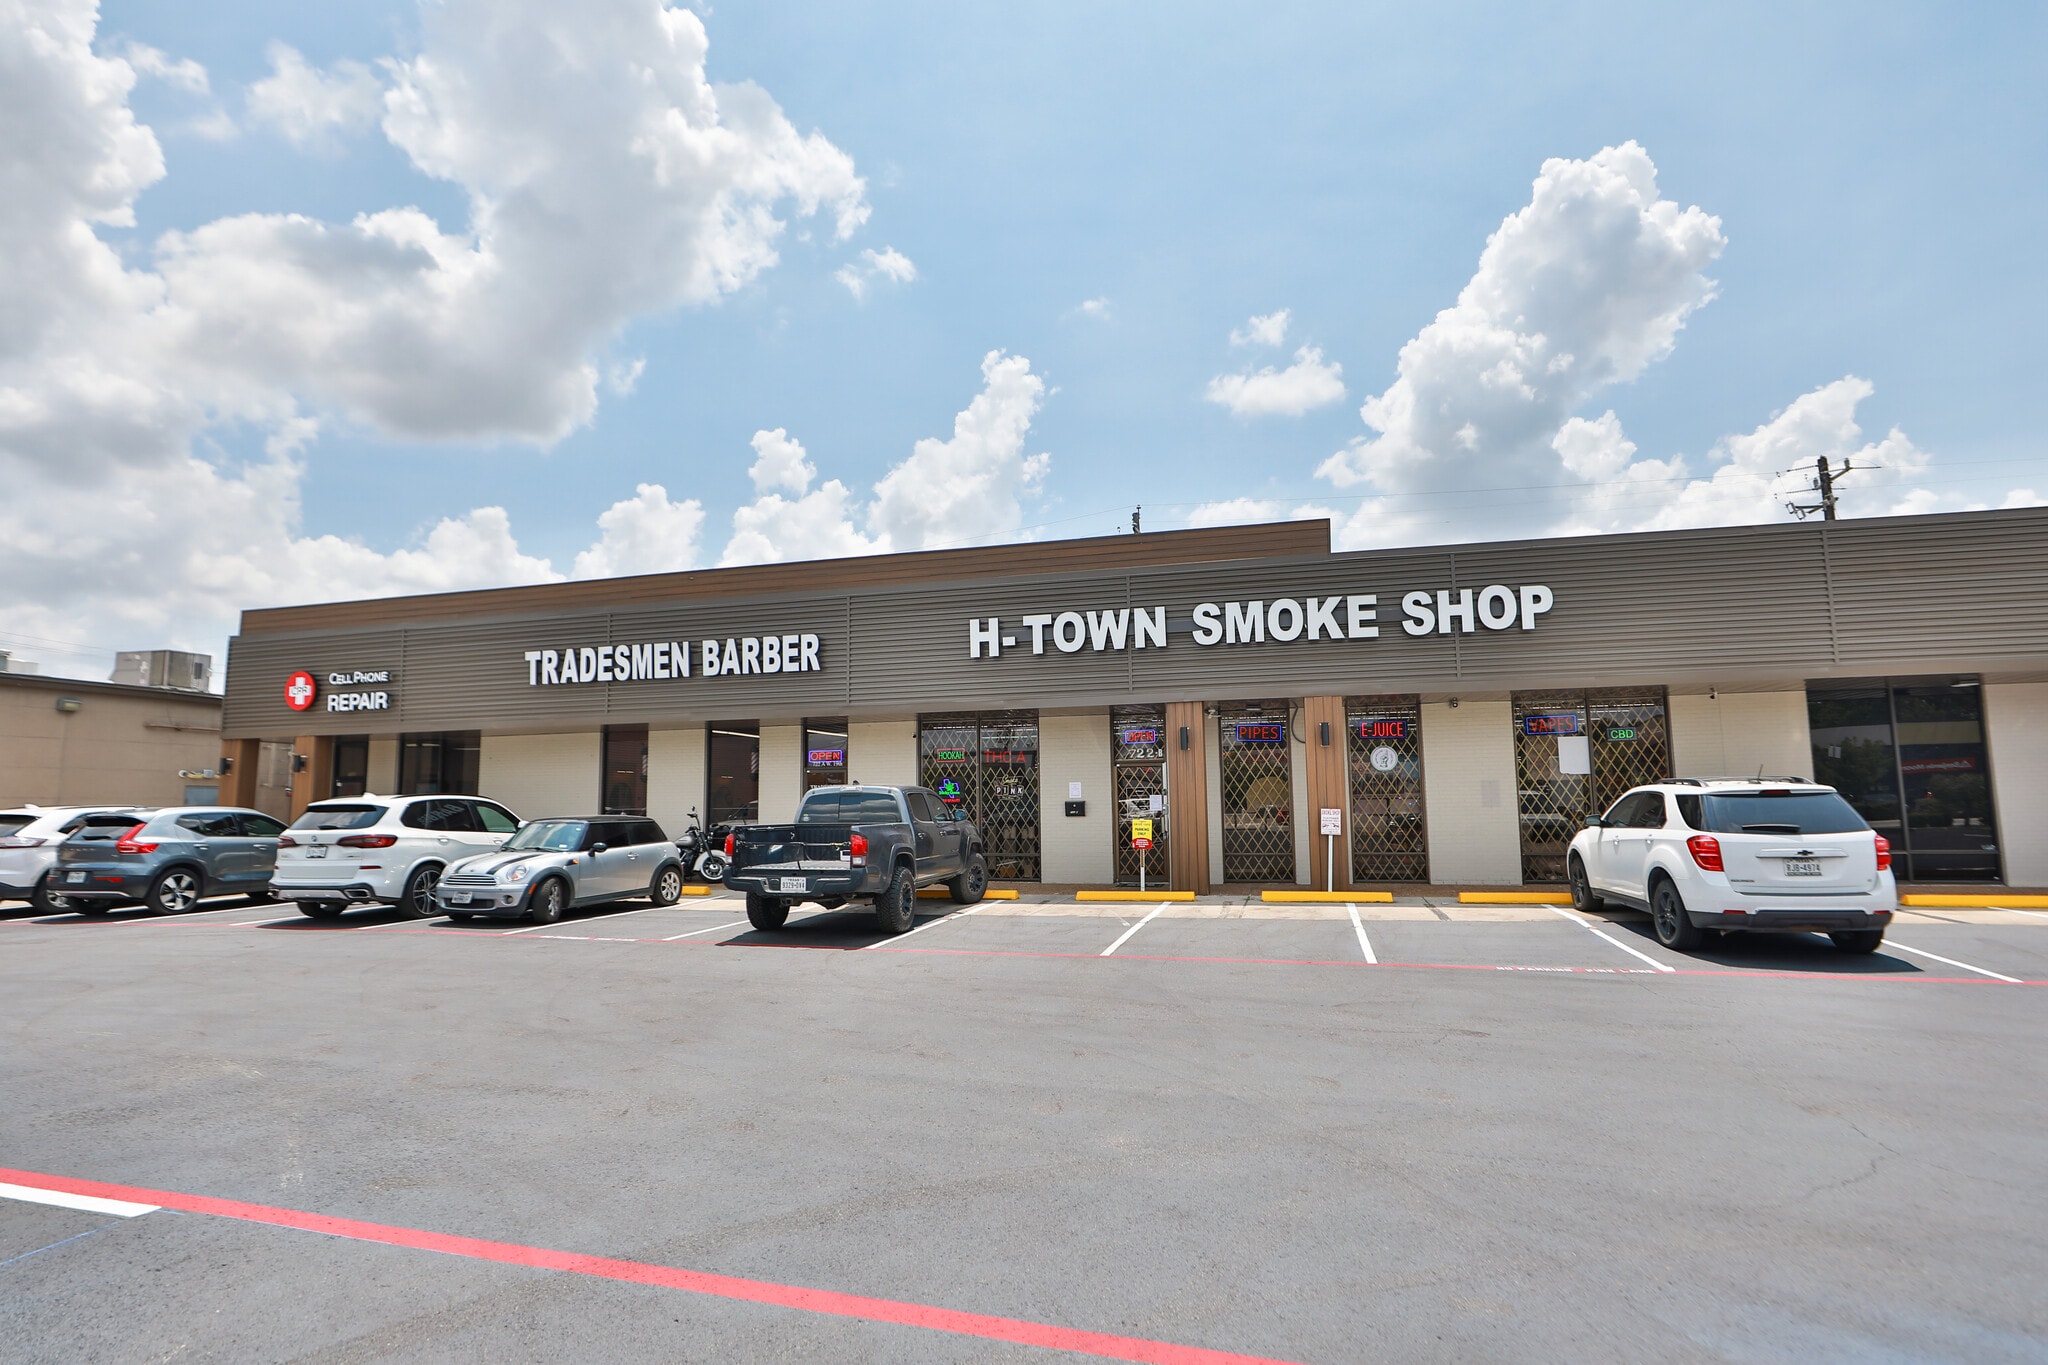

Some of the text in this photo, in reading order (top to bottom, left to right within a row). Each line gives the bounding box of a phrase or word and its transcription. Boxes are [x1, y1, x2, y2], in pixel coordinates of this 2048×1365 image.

[969, 584, 1554, 658] H-TOWN SMOKE SHOP
[524, 634, 821, 686] TRADESMEN BARBER
[329, 671, 389, 685] CELL PHONE
[327, 691, 388, 712] REPAIR
[1361, 722, 1404, 737] E-JUICE
[1529, 716, 1574, 732] VAPES
[1126, 731, 1154, 741] OPEN
[1239, 726, 1279, 740] PIPES
[1610, 729, 1634, 739] CBD
[810, 752, 840, 761] OPEN
[938, 751, 965, 760] HOOKAH
[996, 787, 1023, 795] PINK
